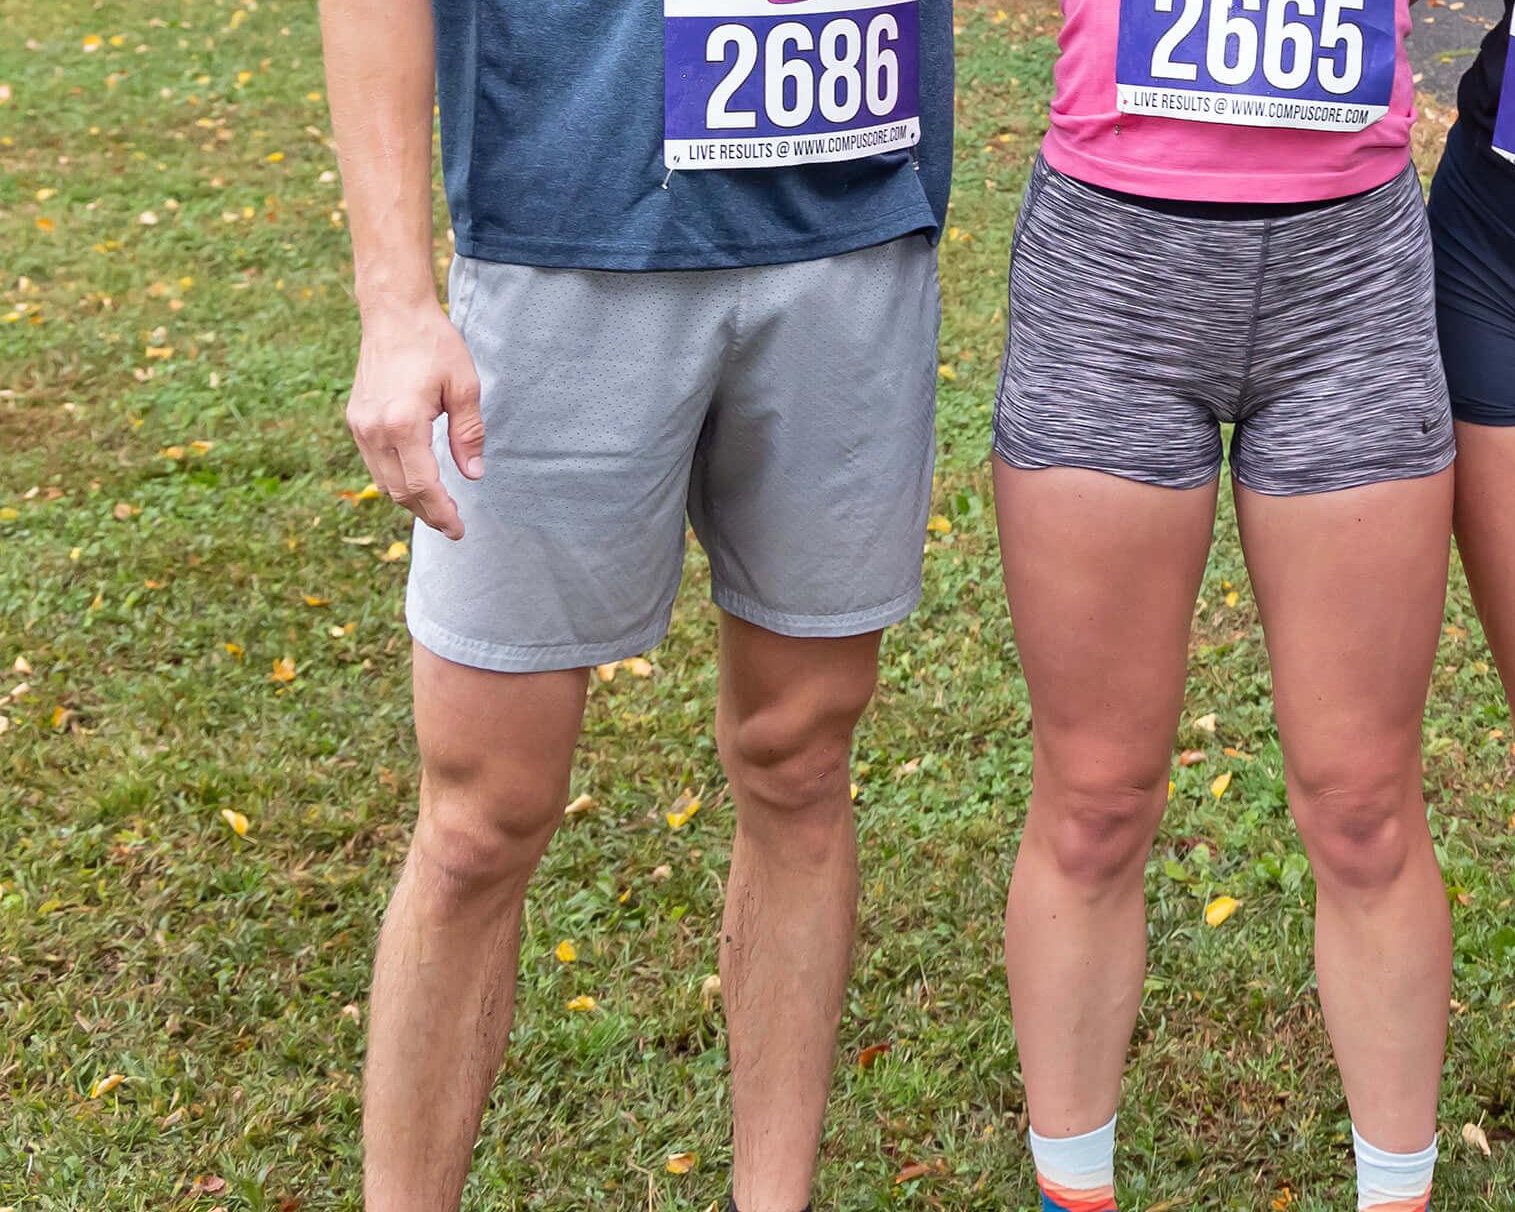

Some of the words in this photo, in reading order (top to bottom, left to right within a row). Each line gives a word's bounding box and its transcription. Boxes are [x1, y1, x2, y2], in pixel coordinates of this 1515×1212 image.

[704, 12, 900, 131] 2686
[1133, 91, 1159, 108] LIVE
[1161, 94, 1210, 113] RESULTS
[1213, 97, 1229, 115] @
[1231, 98, 1370, 125] WWW.COMPUSCORE.COM
[689, 144, 716, 160] LIVE
[719, 142, 772, 160] RESULTS
[776, 141, 791, 158] @
[794, 124, 907, 157] WWW.COMPUSCORE.COM
